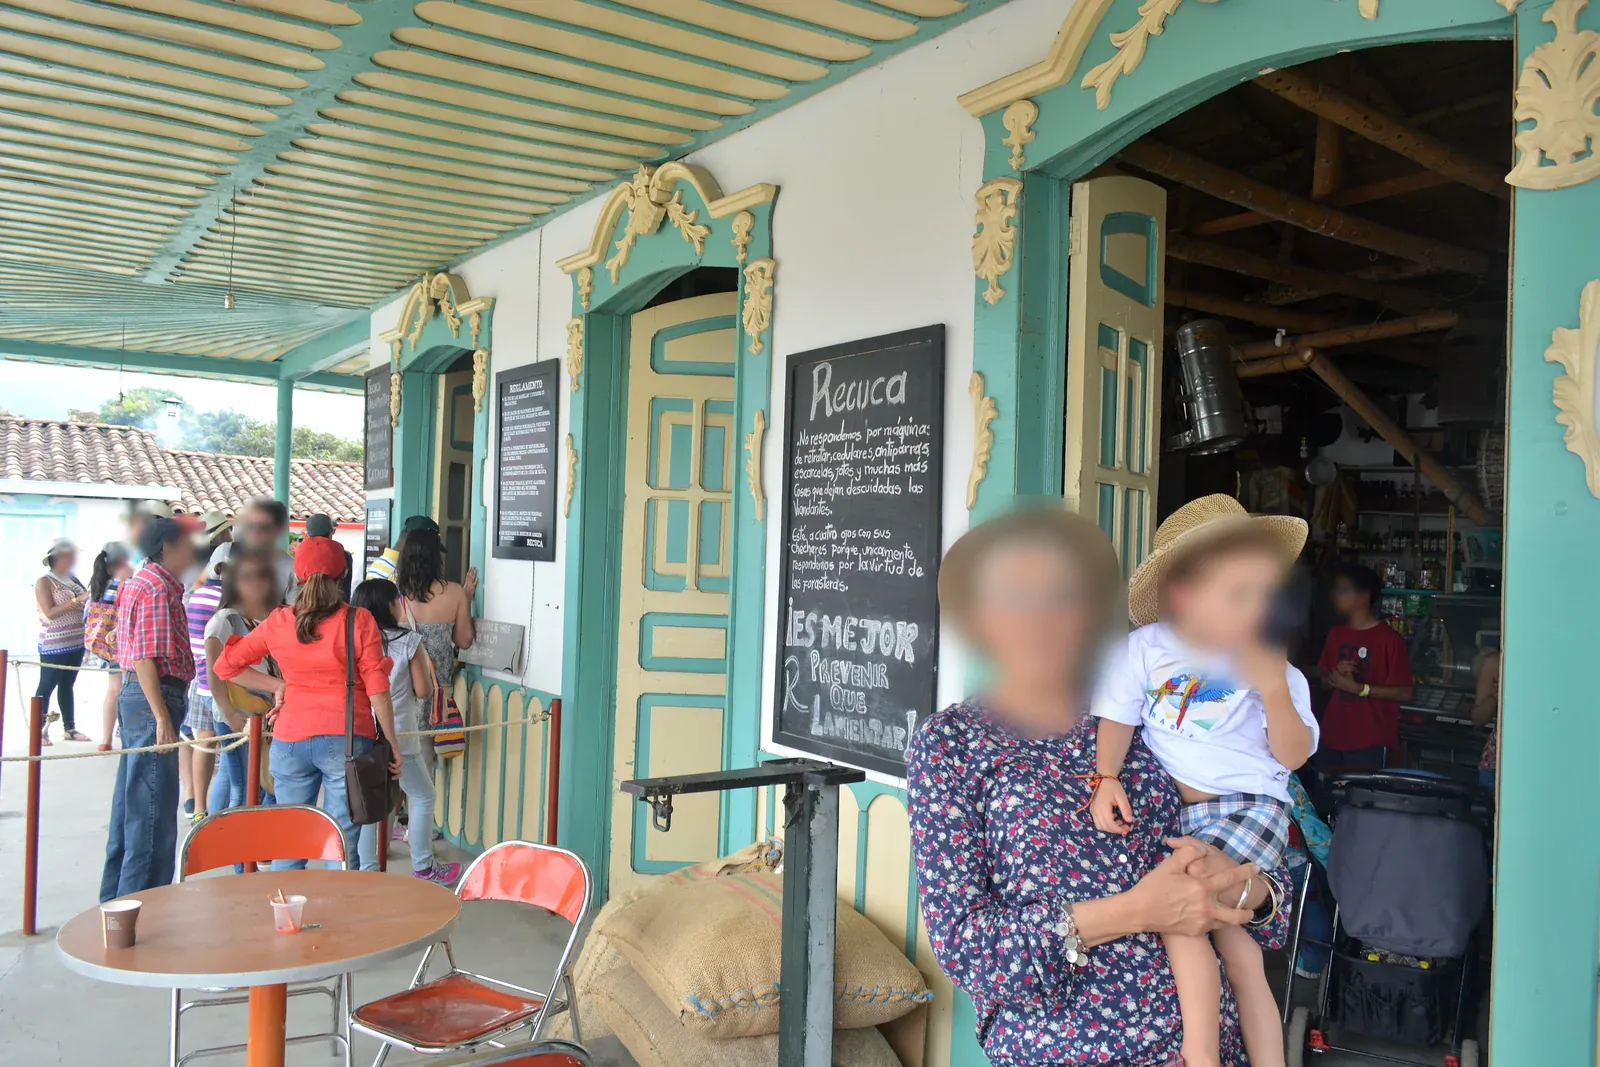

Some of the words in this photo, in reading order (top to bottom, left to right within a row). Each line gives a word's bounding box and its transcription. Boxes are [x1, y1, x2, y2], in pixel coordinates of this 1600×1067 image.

[509, 379, 543, 393] REGLAMENTO
[810, 362, 908, 421] Recuca
[810, 419, 862, 448] respondemos
[866, 425, 882, 444] por
[794, 448, 802, 465] de
[854, 466, 862, 481] y
[865, 459, 901, 475] muchas
[905, 456, 928, 473] más
[812, 486, 824, 502] que
[824, 481, 844, 501] dejan
[846, 478, 902, 495] descuidadas
[908, 476, 924, 494] las
[809, 532, 815, 541] a
[841, 530, 857, 545] ojos
[873, 528, 891, 540] sus
[792, 555, 834, 575] respondemos
[839, 560, 854, 575] por
[858, 553, 868, 571] la
[908, 559, 924, 577] de
[792, 573, 801, 589] las
[821, 615, 919, 664] MEJOR
[810, 650, 889, 689] PREVENIR
[830, 684, 867, 714] QUE
